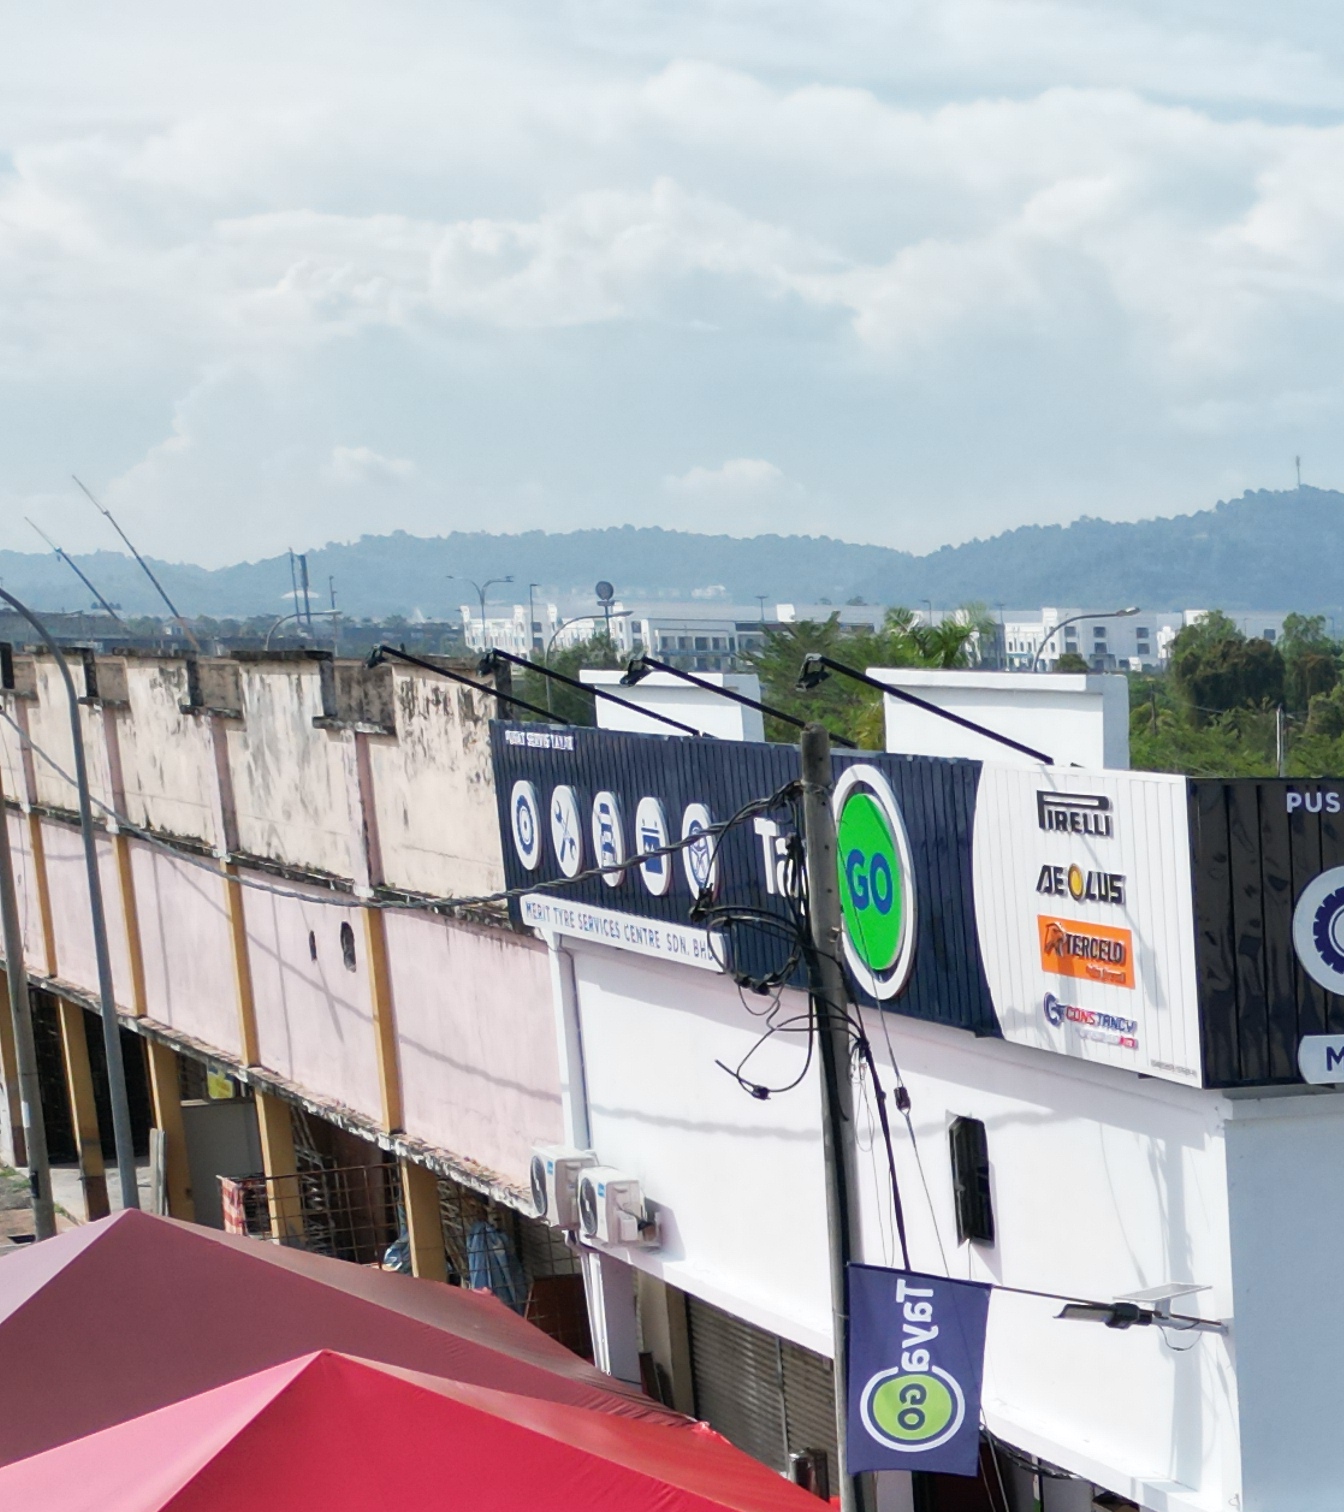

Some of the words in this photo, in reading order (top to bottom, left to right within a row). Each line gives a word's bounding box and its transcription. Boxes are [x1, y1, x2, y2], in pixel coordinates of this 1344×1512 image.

[1036, 790, 1110, 837] PIRELLI
[846, 849, 893, 915] GO
[1036, 863, 1126, 904] AEOLUS
[526, 901, 550, 922] MERIT
[553, 907, 575, 929] TYRE
[578, 915, 621, 940] SERVICES
[624, 923, 661, 949] CENTRE
[1065, 933, 1126, 966] TERCELO
[1066, 1006, 1136, 1033] CONSTANCY
